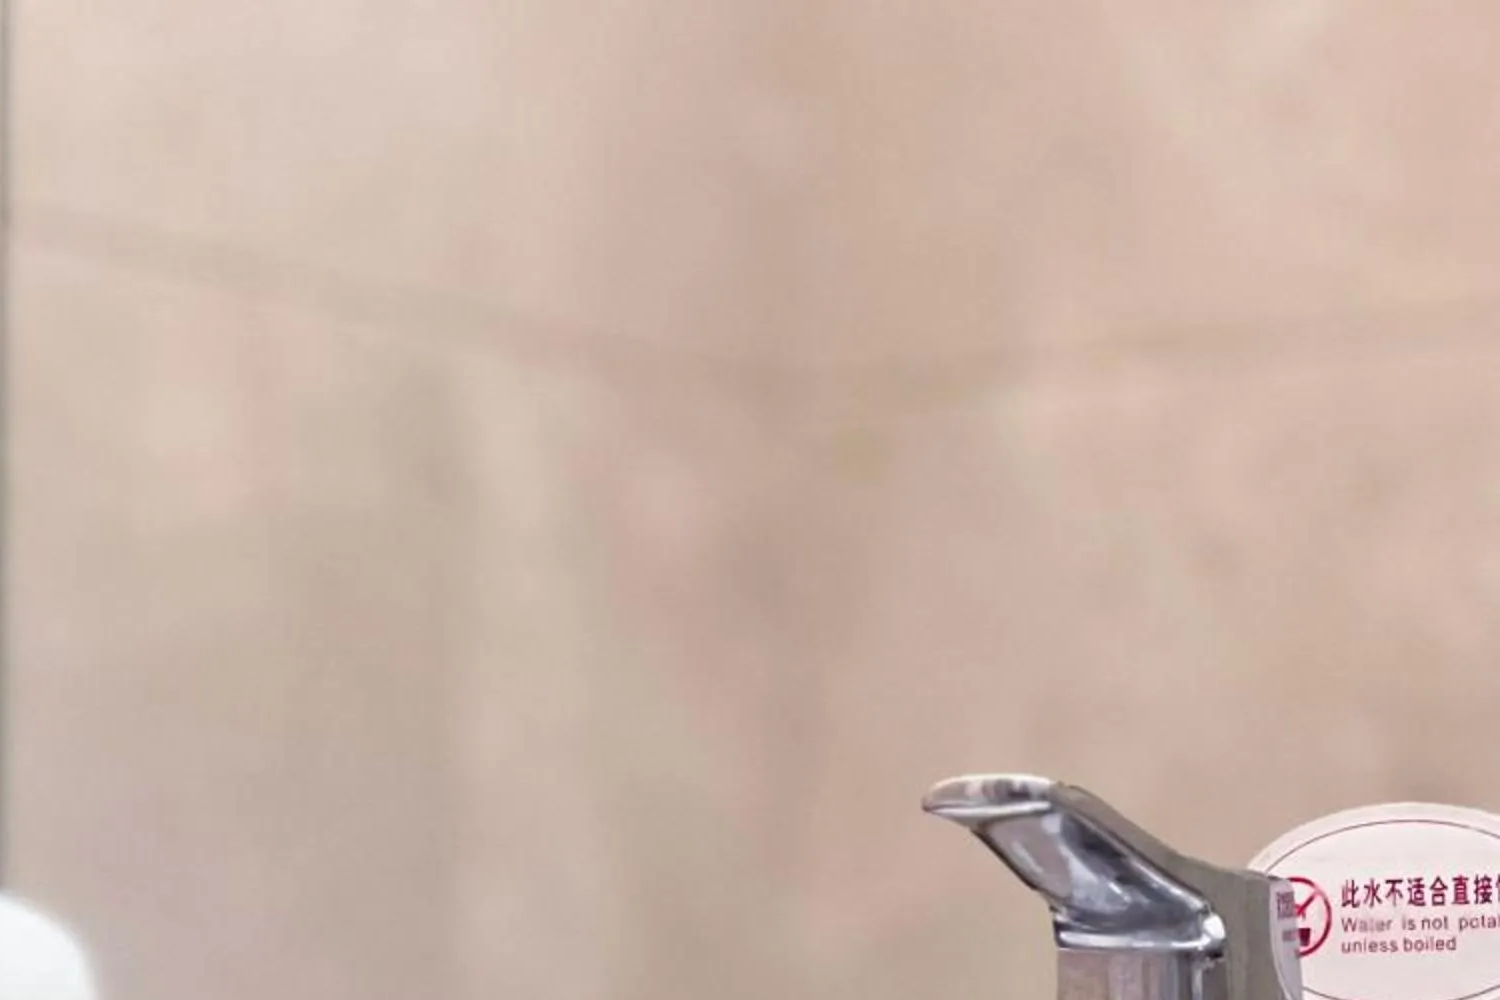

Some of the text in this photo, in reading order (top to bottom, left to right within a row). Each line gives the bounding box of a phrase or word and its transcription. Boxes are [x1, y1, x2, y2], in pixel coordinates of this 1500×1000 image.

[1341, 917, 1392, 933] Water
[1402, 916, 1416, 931] is
[1421, 915, 1449, 931] not
[1341, 936, 1457, 954] unless boiled
